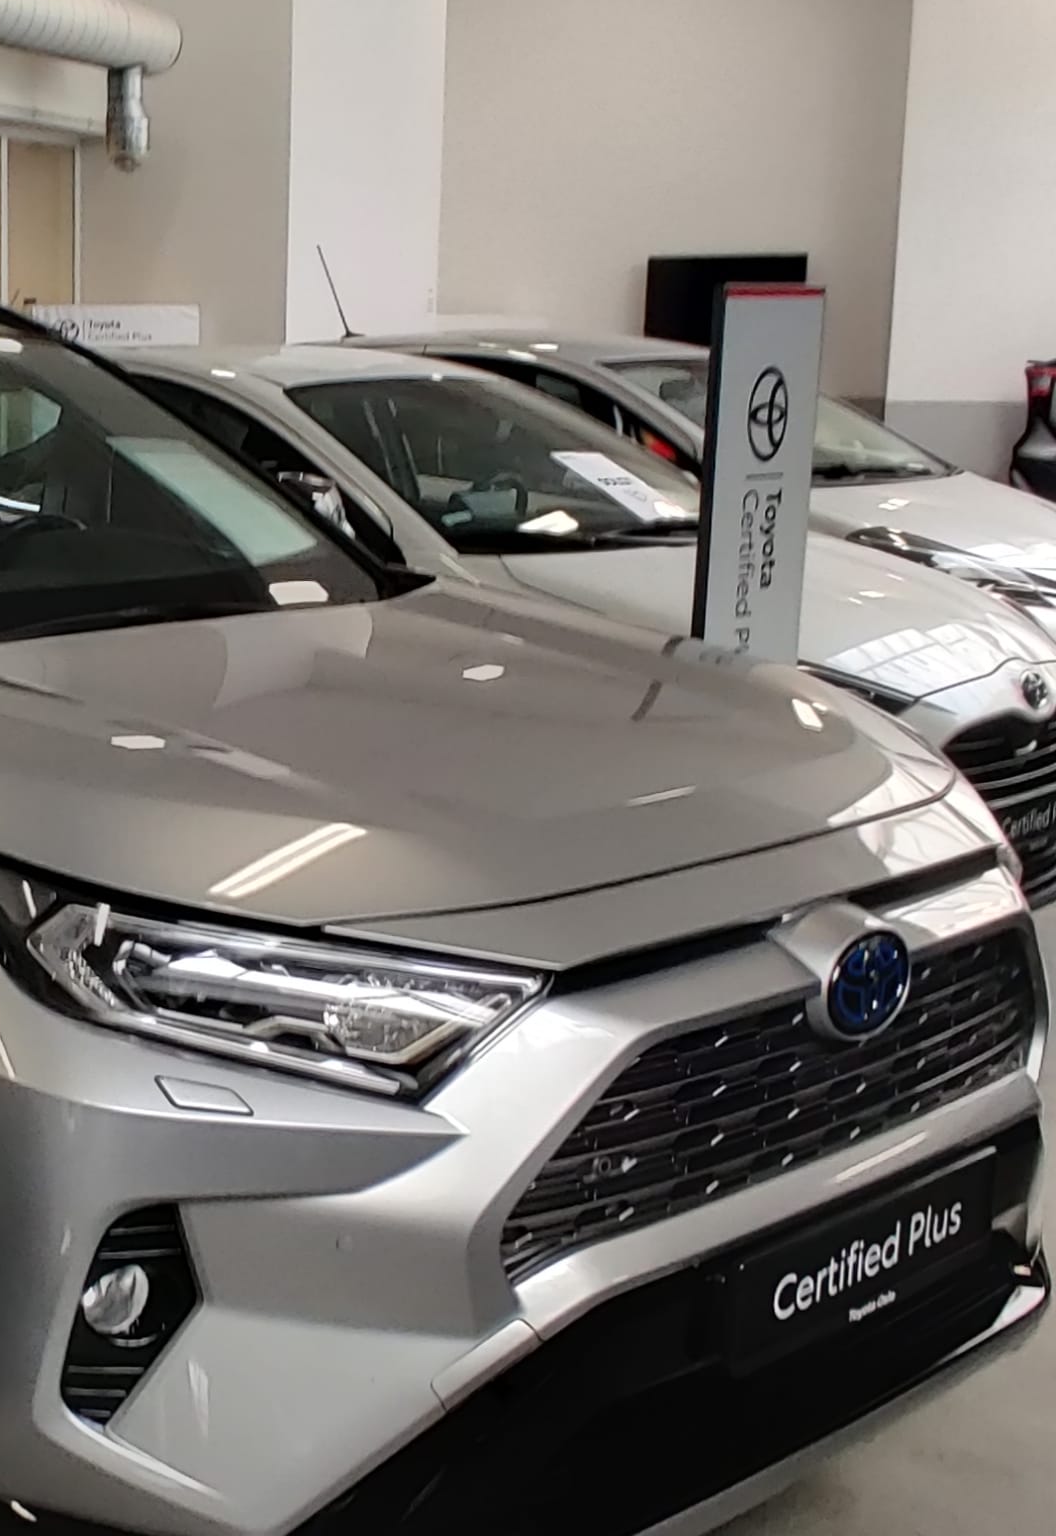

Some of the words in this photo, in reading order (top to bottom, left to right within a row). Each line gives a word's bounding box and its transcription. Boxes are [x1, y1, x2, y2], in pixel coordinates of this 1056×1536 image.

[735, 488, 759, 618] Certified
[759, 487, 783, 589] Toyota
[773, 1220, 902, 1321] Certified
[907, 1201, 962, 1256] Plus
